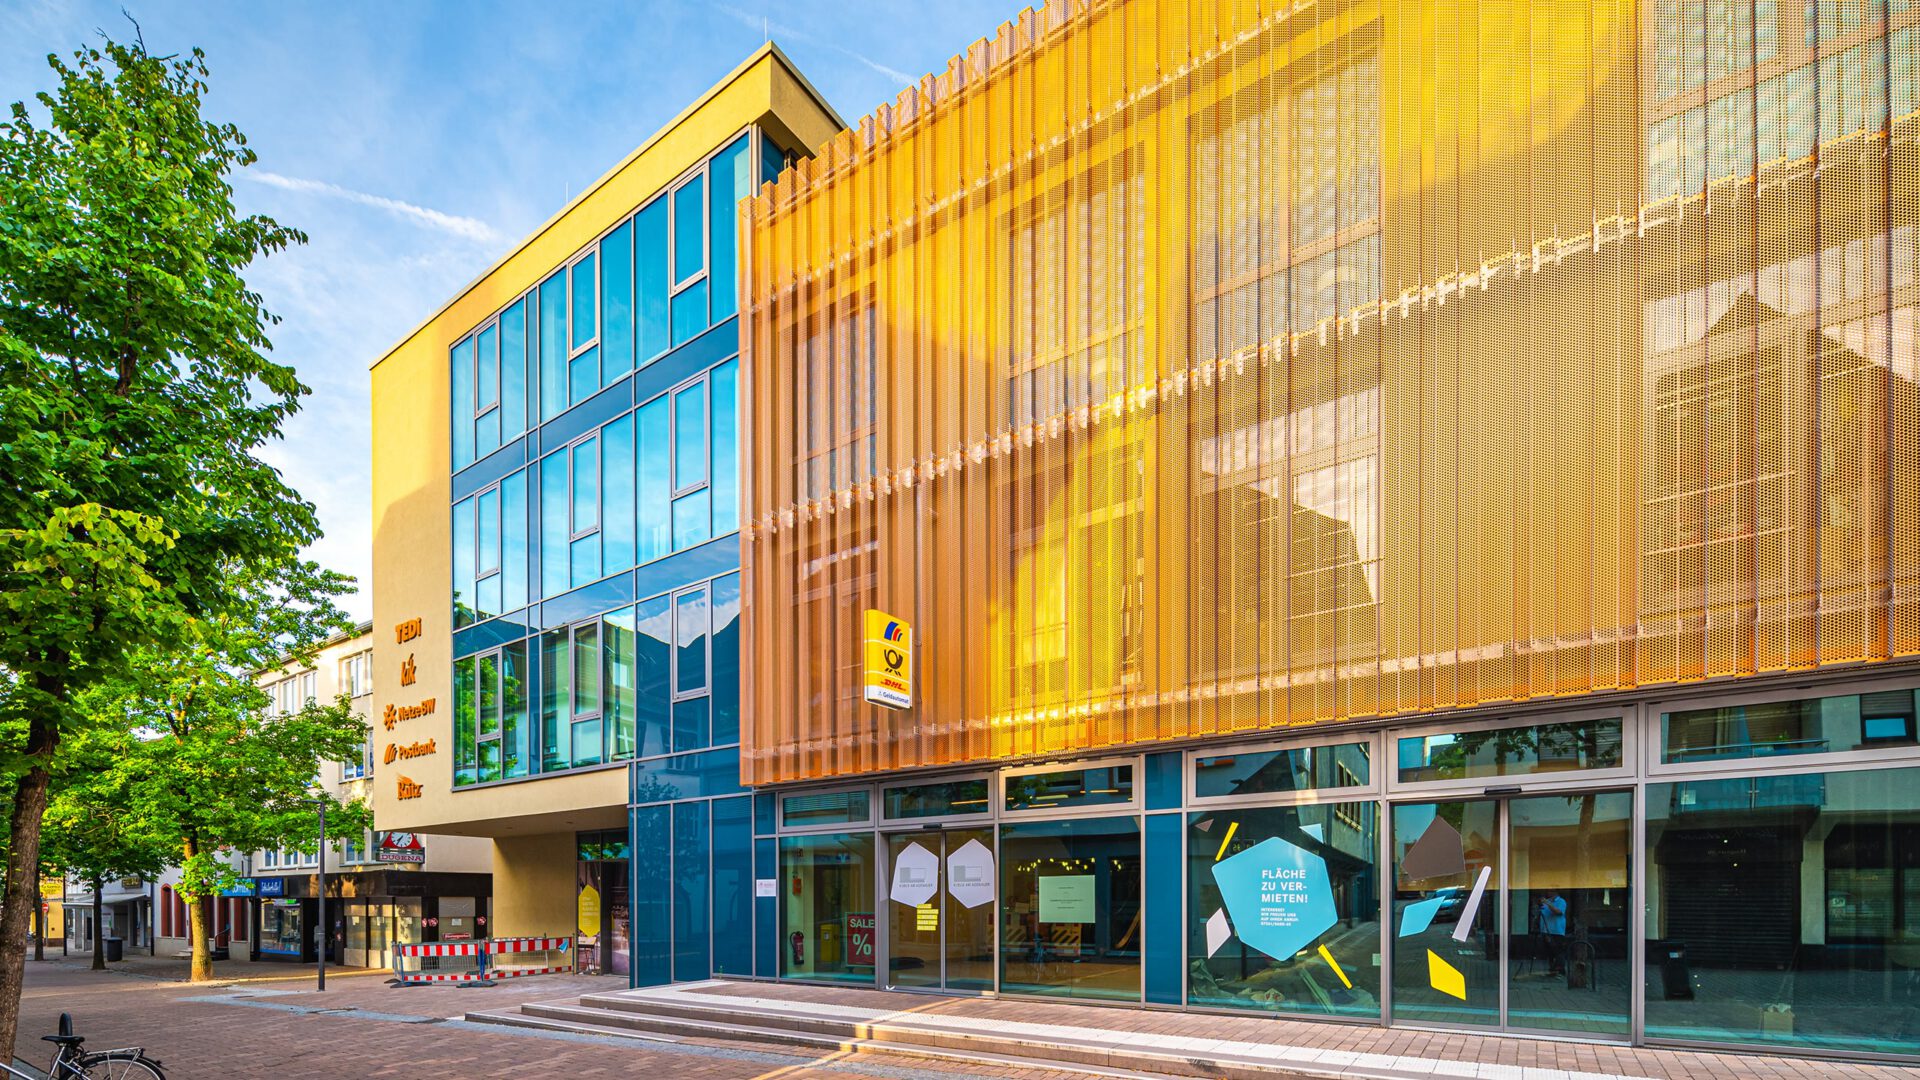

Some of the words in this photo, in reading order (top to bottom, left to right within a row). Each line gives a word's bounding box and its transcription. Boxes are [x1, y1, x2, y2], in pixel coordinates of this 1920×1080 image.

[395, 617, 422, 644] TEDi
[881, 679, 906, 692] DHL
[883, 691, 909, 704] Geldautomat
[399, 738, 436, 760] Postbank
[1262, 868, 1306, 879] FLÄCHE
[1261, 882, 1276, 891] ZU
[1280, 882, 1307, 891] VER-
[1261, 894, 1308, 903] MIETEN!
[850, 918, 875, 928] SALE
[853, 933, 872, 956] %
